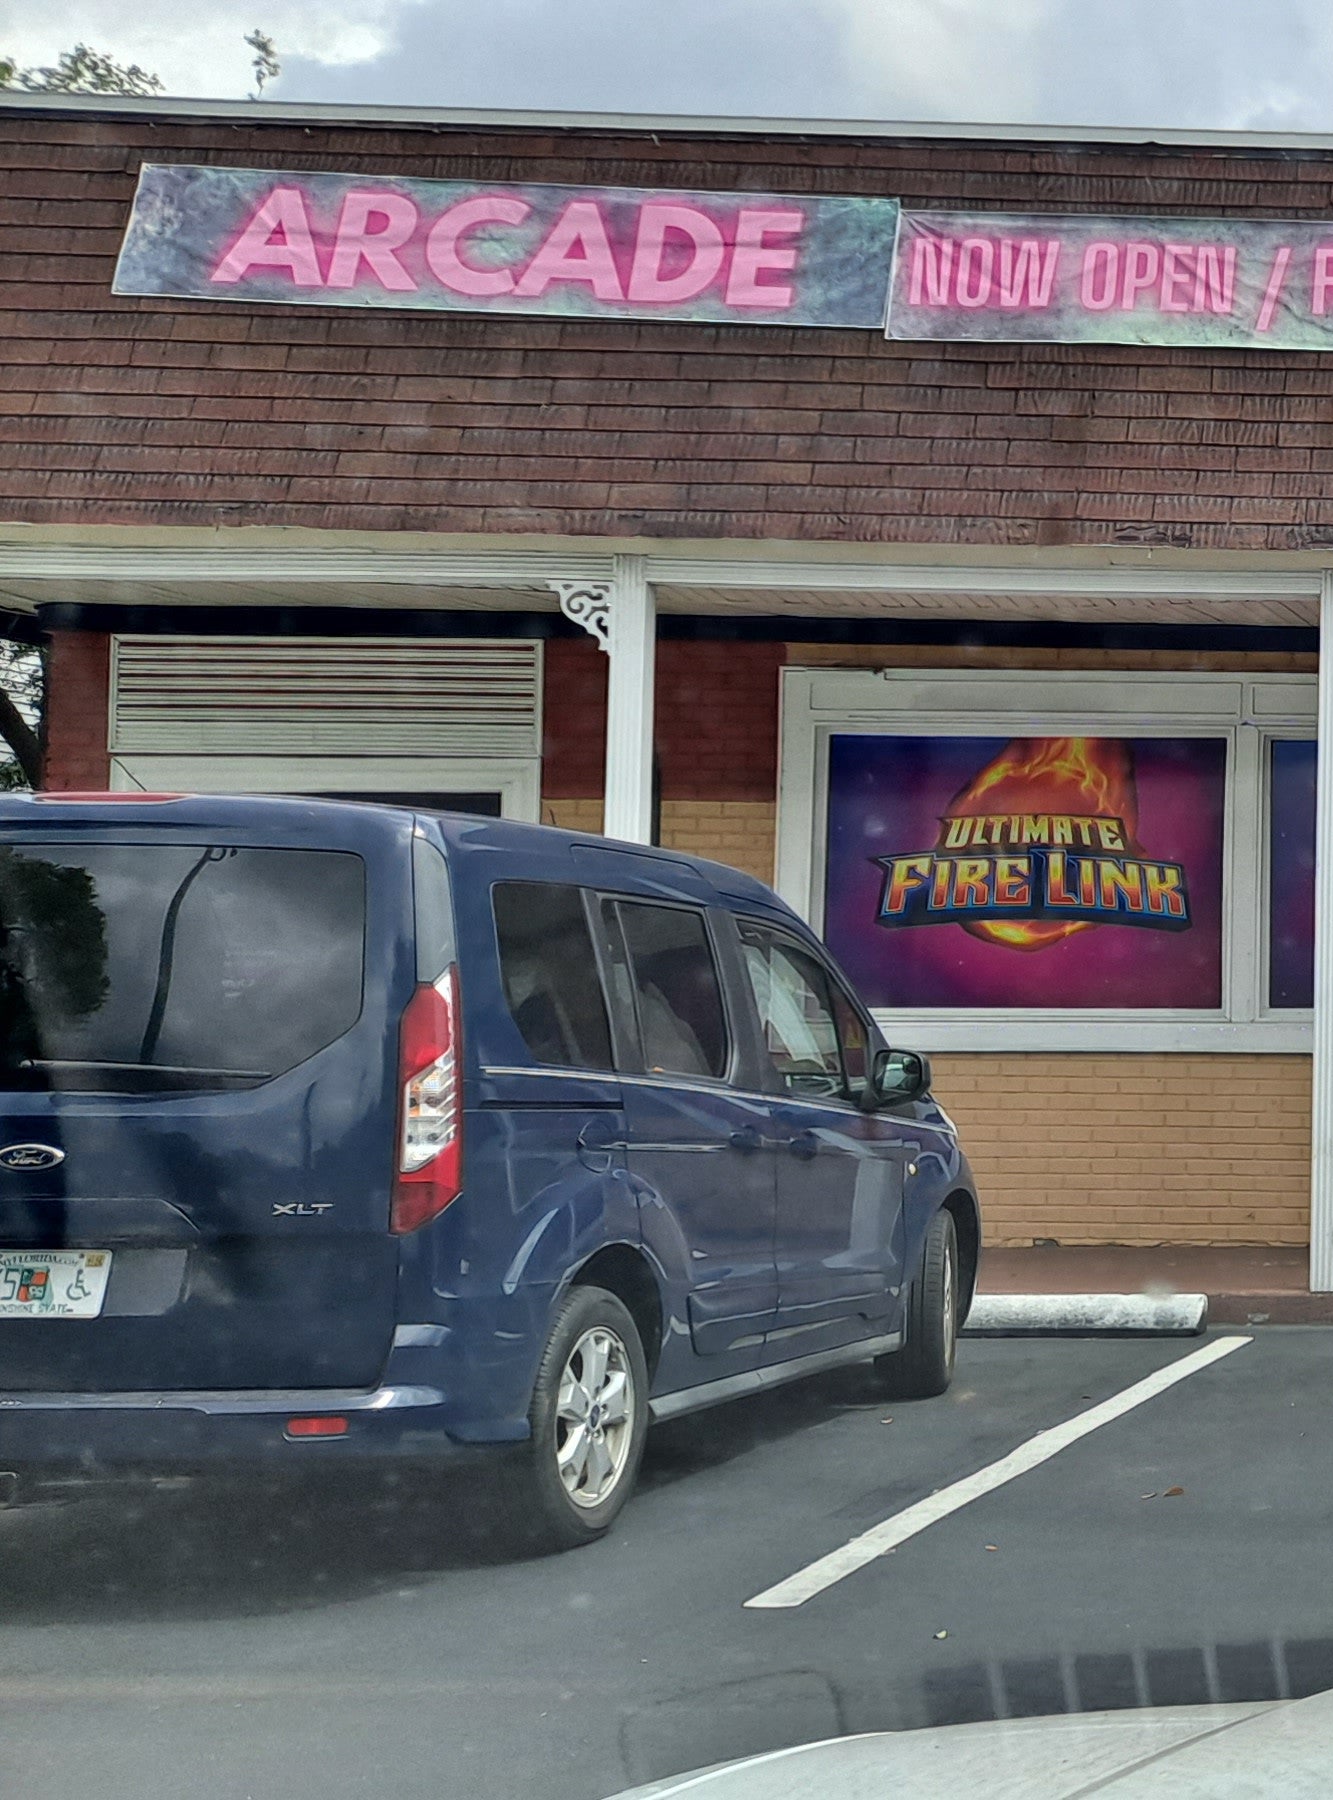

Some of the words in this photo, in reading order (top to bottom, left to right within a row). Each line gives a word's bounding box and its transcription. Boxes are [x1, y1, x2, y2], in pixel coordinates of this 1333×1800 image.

[209, 188, 805, 307] ARCADE
[908, 237, 1060, 307] NOW
[1080, 241, 1237, 314] OPEN
[944, 815, 1125, 851] ULTIMATE
[880, 853, 1032, 916] FIRE
[1044, 849, 1187, 918] LINK
[271, 1203, 334, 1215] XLT
